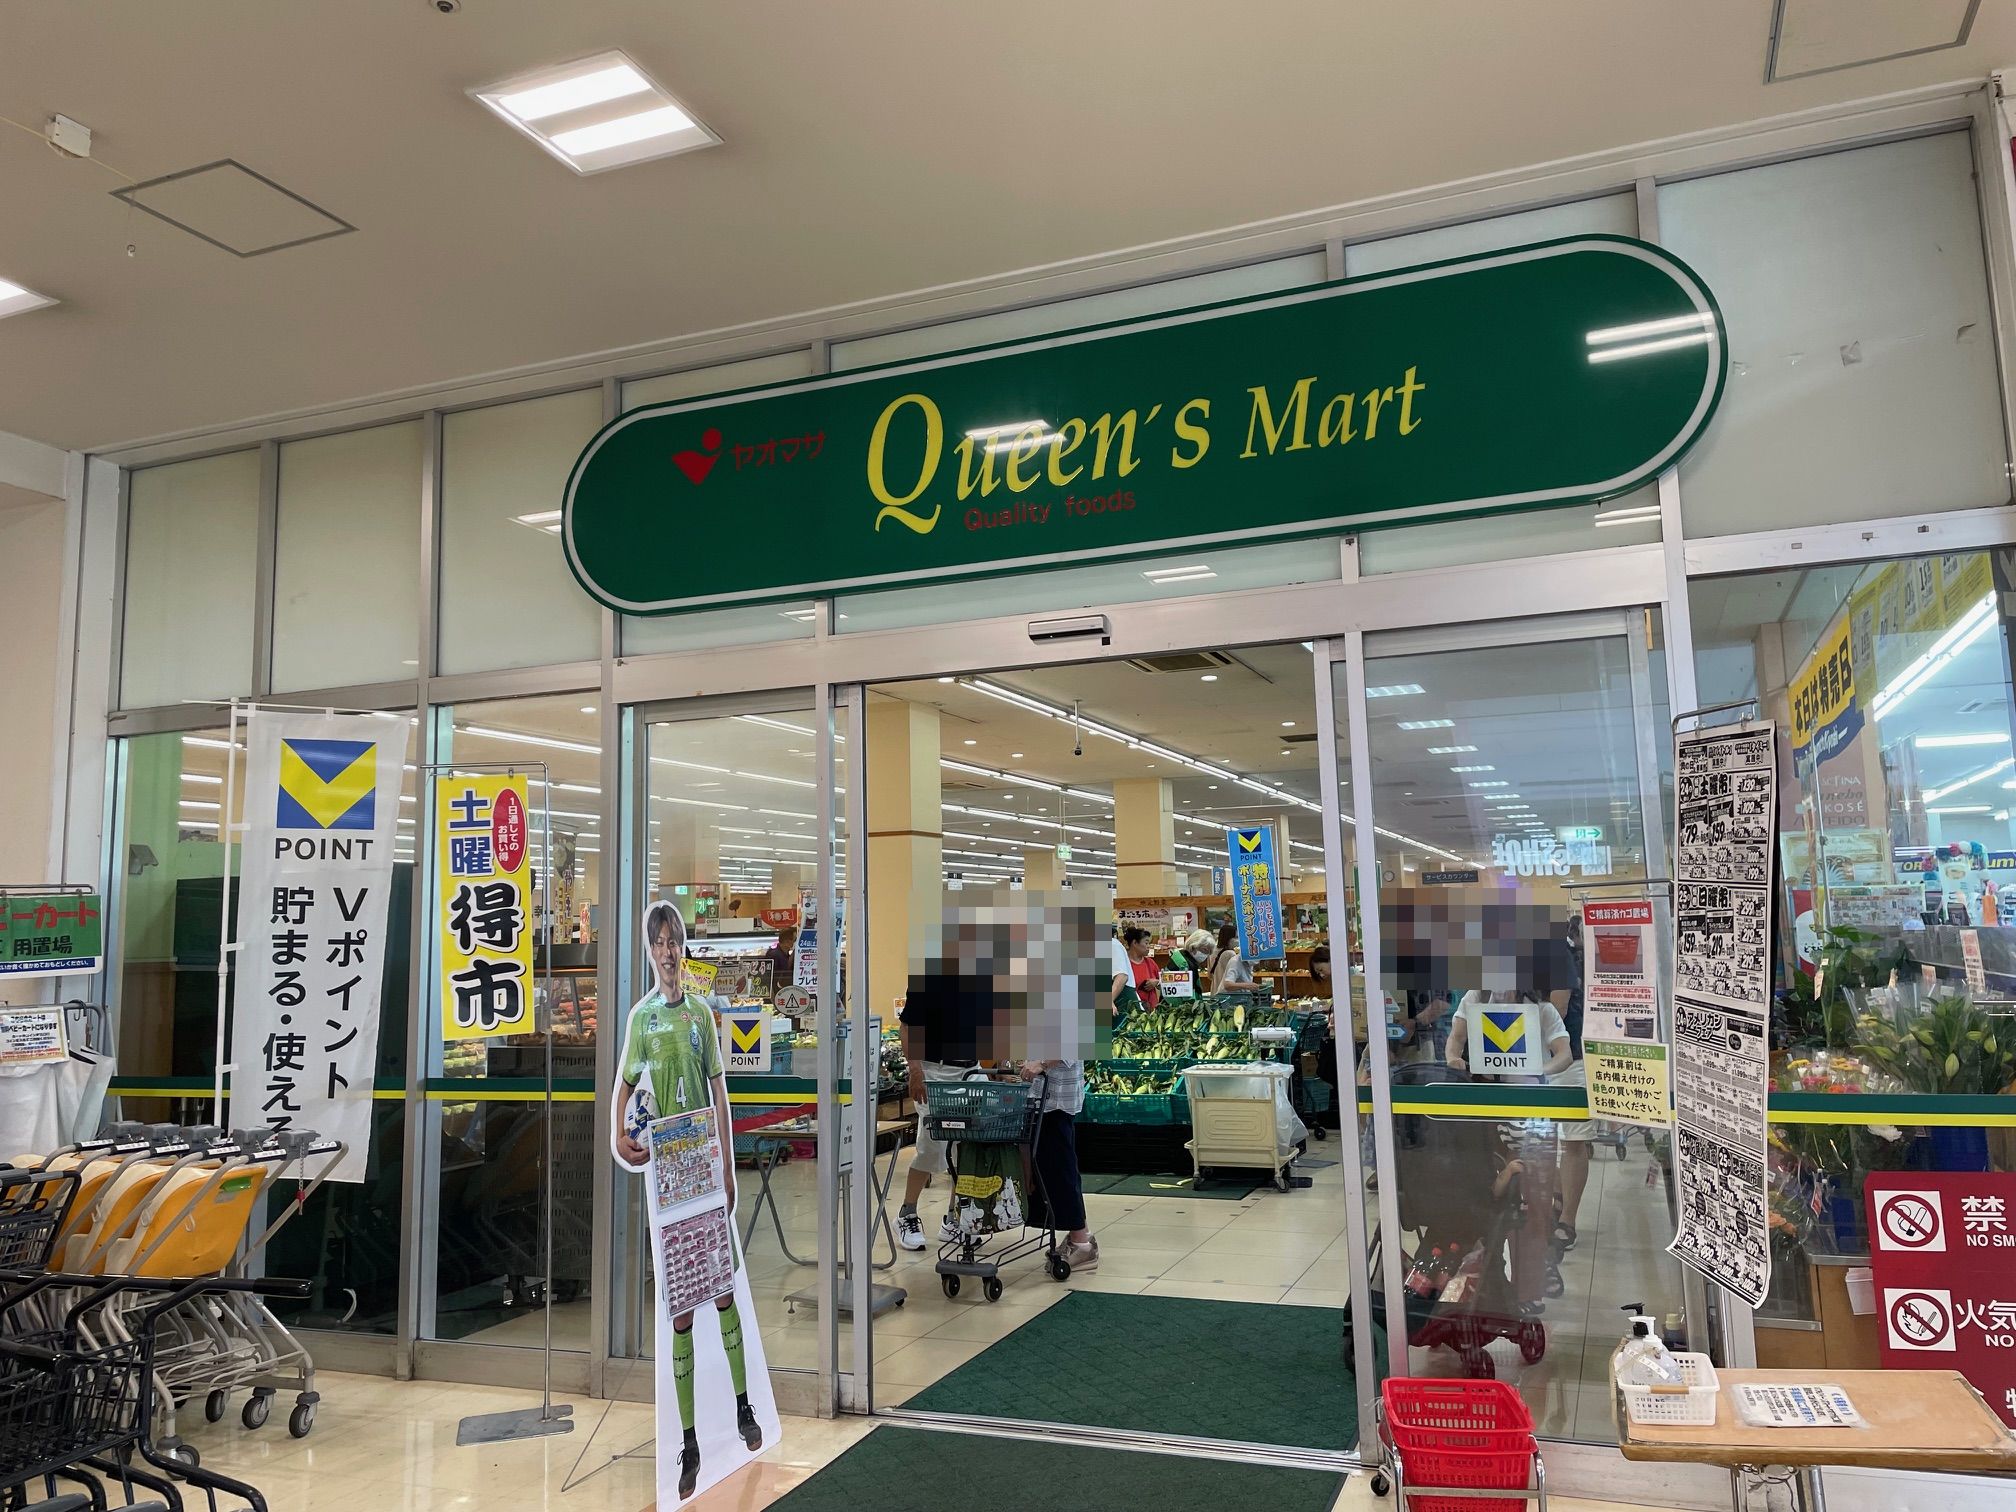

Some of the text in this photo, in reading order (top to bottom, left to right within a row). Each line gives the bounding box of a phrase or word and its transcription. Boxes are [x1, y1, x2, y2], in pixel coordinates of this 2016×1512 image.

[731, 430, 826, 471] ヤオマサ
[866, 365, 1426, 534] Queen's Mart
[964, 488, 1137, 531] Quality foods
[1825, 800, 1865, 813] KOSÉ
[508, 797, 520, 851] 1日通しての
[275, 838, 375, 861] POINT
[497, 825, 509, 862] お買い得
[1251, 862, 1272, 896] 特別
[448, 790, 525, 1030] 土曜得市
[1119, 909, 1151, 919] まごころ市
[0, 935, 73, 958] 用置場
[323, 887, 368, 1099] Vポイント
[1163, 986, 1177, 996] 150
[1687, 1012, 1723, 1032] アメリカン
[730, 1057, 760, 1066] POINT
[1484, 1057, 1527, 1068] POINT
[1600, 1058, 1647, 1072] ご精算前は、
[1595, 1070, 1655, 1085] 店内備え付けの
[676, 1076, 687, 1108] 4
[1592, 1083, 1662, 1100] 緑色の買い物かご
[1594, 1096, 1661, 1115] をお使いください。
[1961, 1195, 2007, 1231] 禁
[1966, 1234, 1989, 1247] NO
[1955, 1299, 2016, 1331] 火気
[1985, 1334, 2015, 1348] NO
